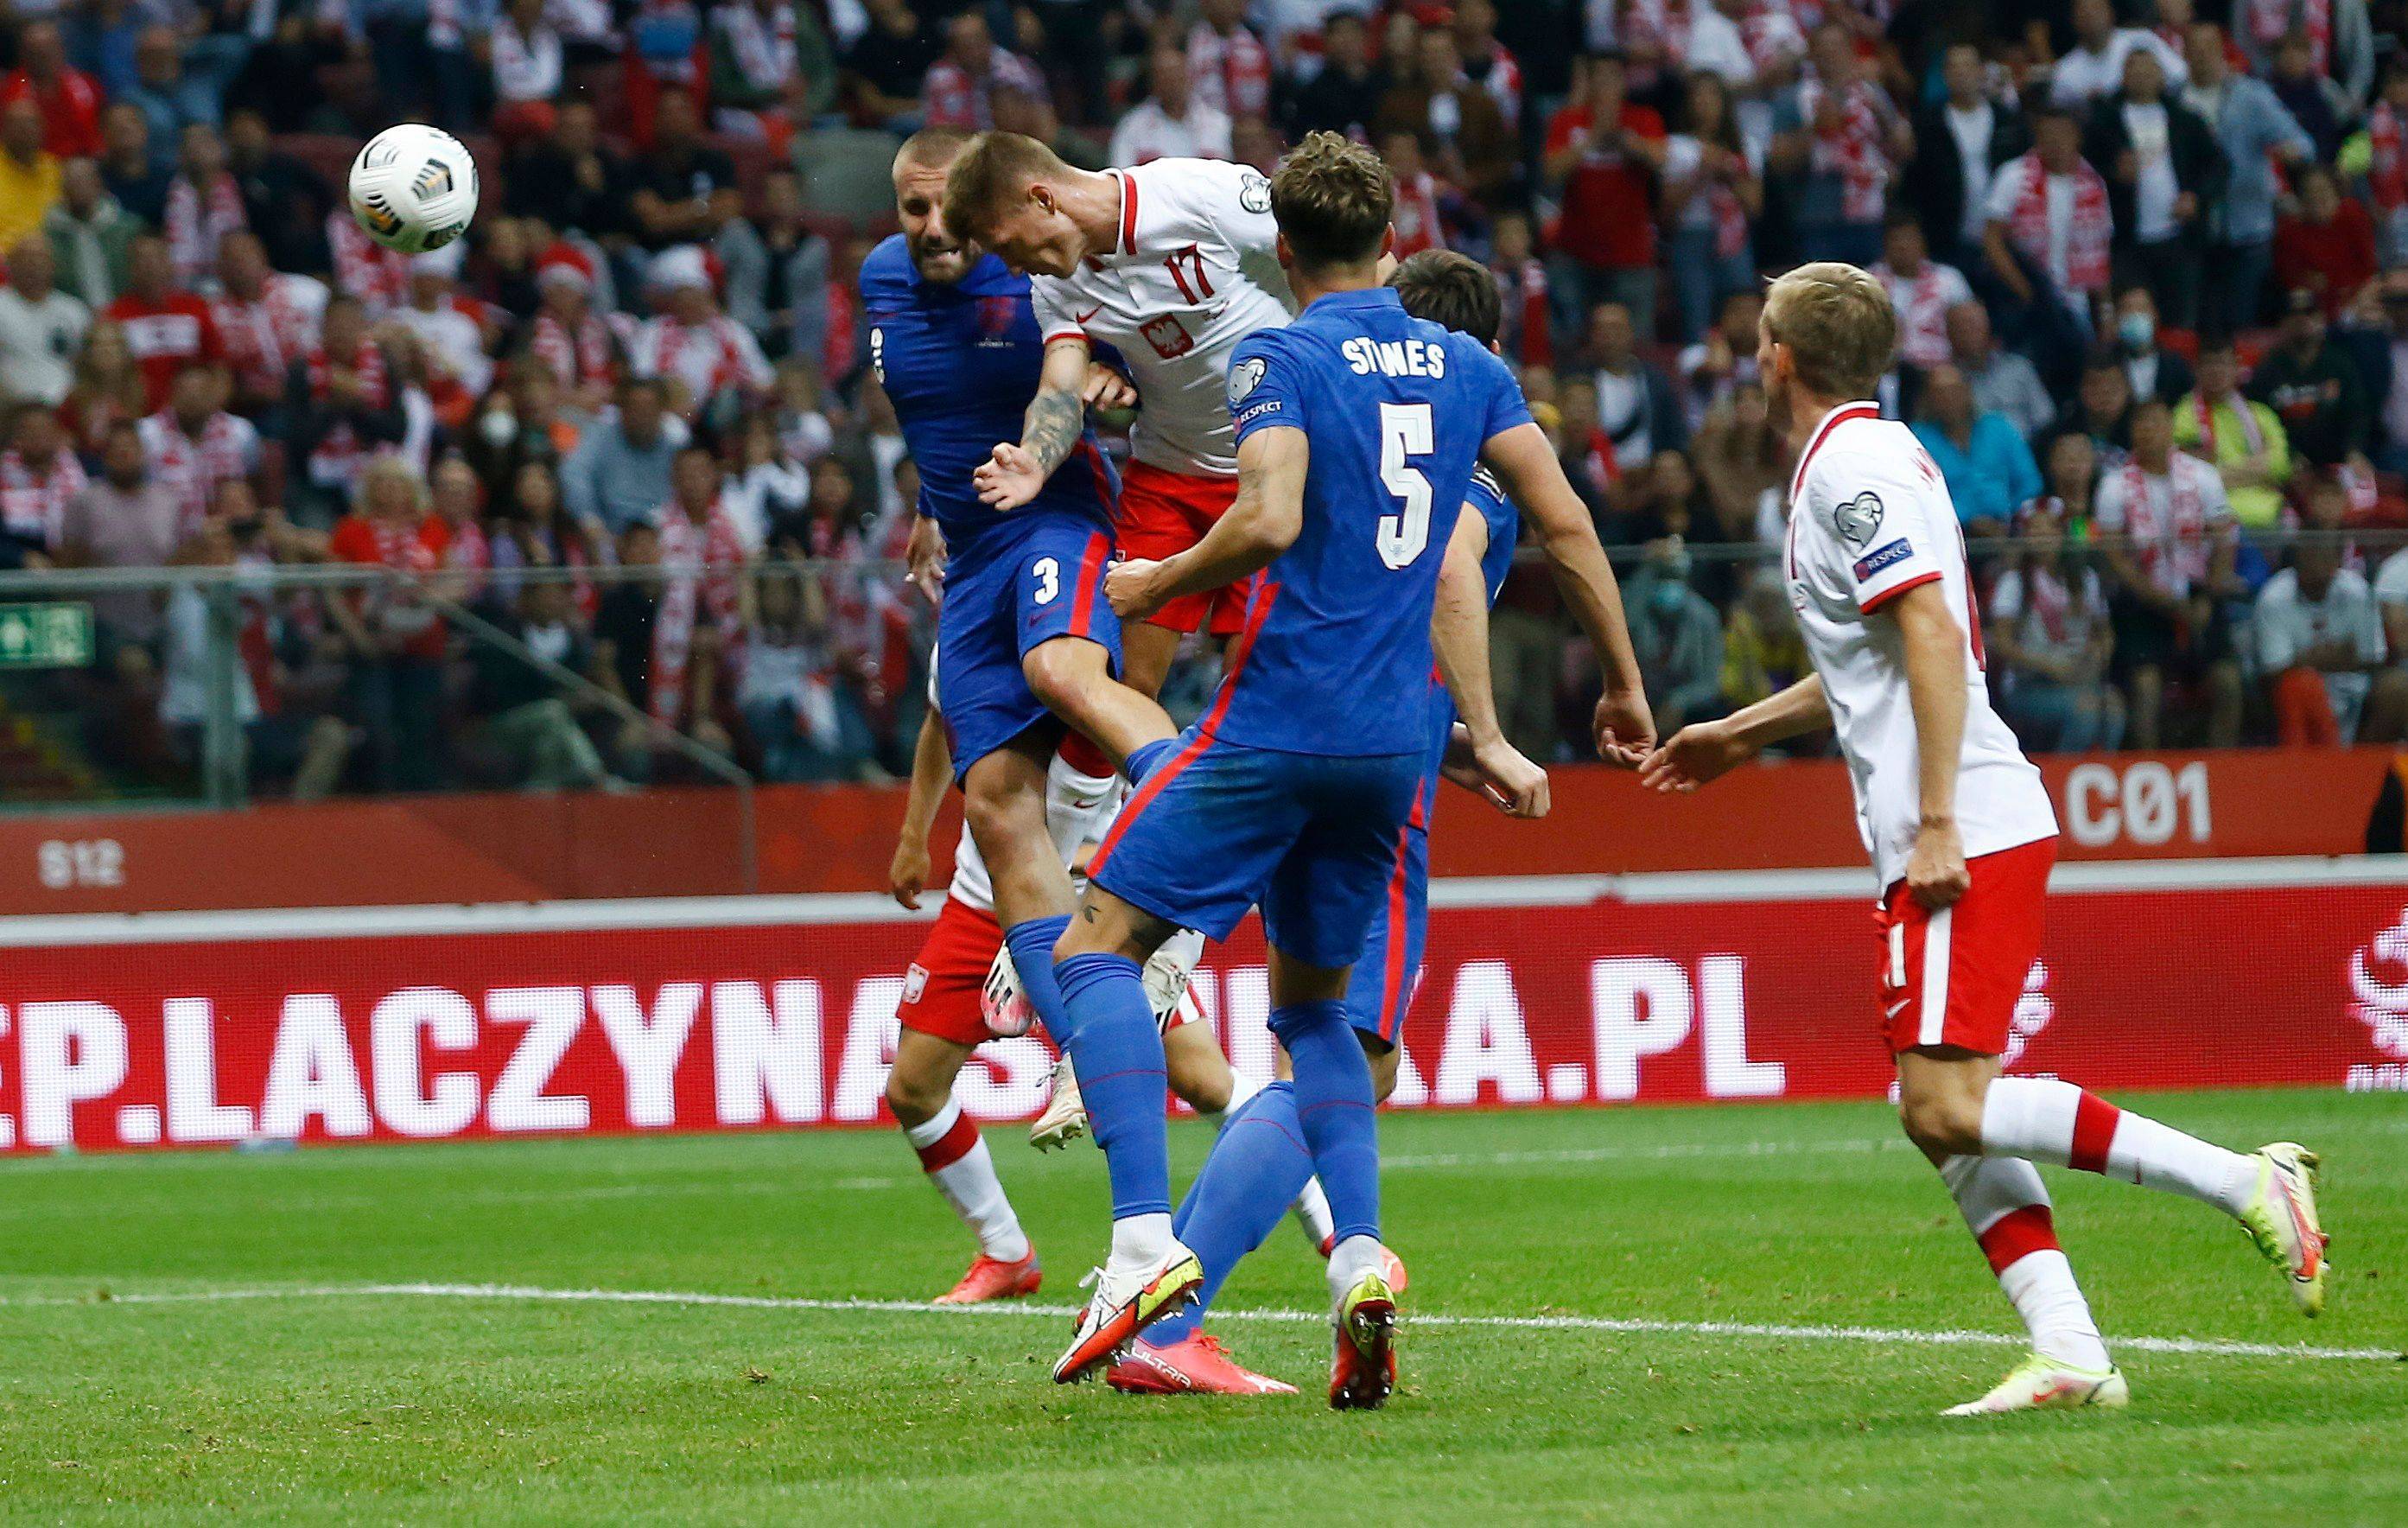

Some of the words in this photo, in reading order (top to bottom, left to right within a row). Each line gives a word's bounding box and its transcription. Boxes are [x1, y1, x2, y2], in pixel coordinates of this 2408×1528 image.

[1163, 245, 1215, 306] 17
[1240, 401, 1282, 424] RESPECT
[1376, 404, 1434, 570] 5
[1032, 556, 1060, 606] 3
[0, 953, 1787, 1149] P.LACZYNASLA.PL
